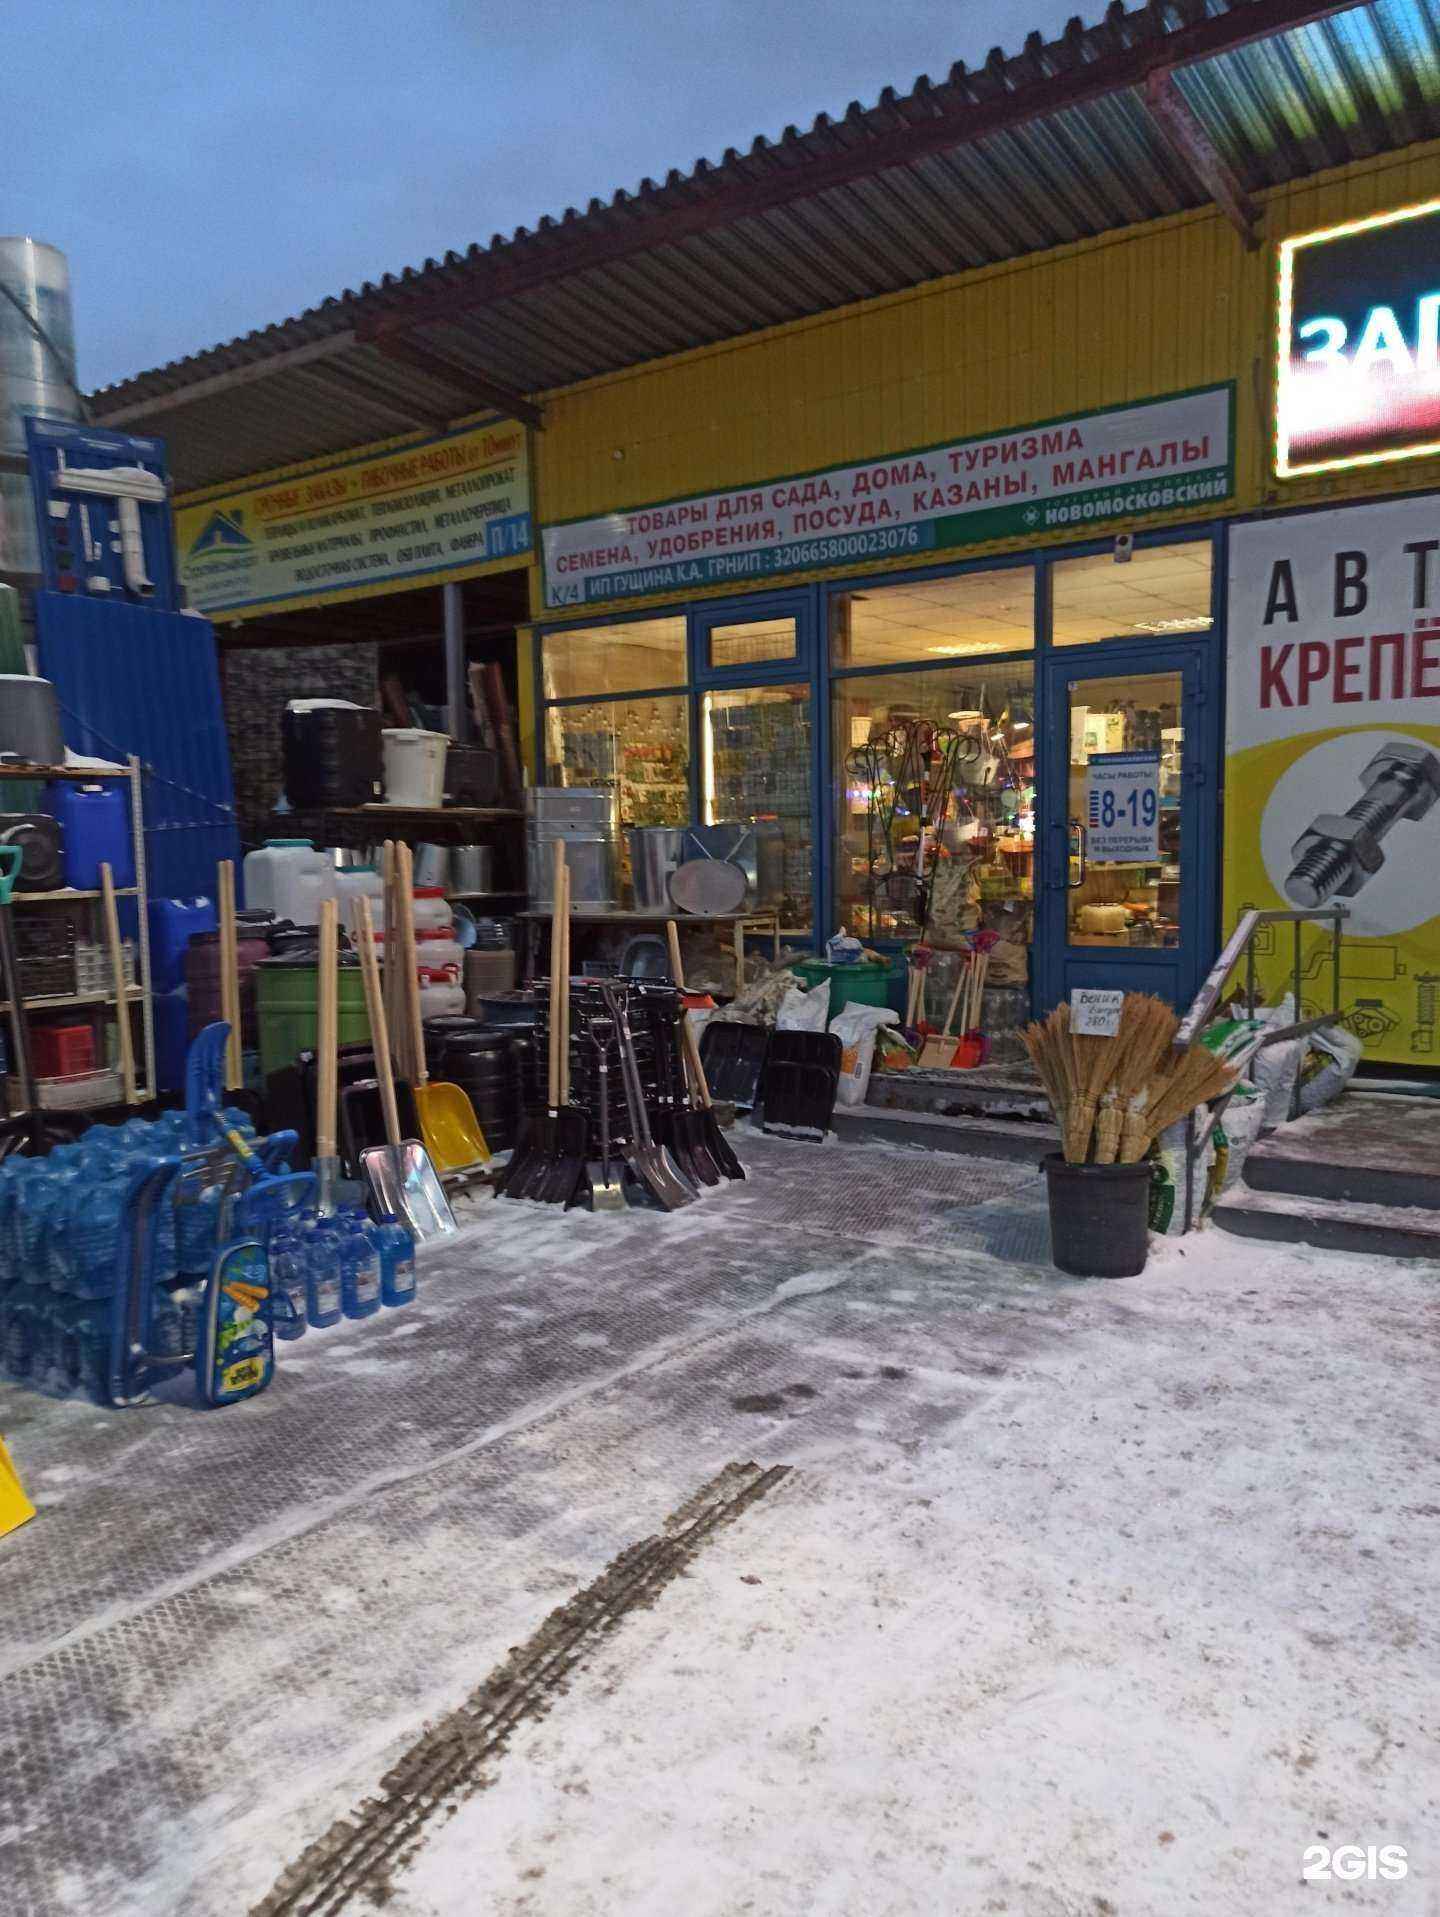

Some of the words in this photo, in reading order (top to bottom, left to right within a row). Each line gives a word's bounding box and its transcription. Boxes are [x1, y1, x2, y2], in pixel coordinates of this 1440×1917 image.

[556, 545, 639, 574] СЕМЕНА,
[646, 519, 784, 560] УДОБРЕНИЯ,
[793, 497, 901, 534] ПОСУДА,
[912, 471, 1038, 514] КАЗАНЫ,
[1052, 435, 1210, 487] МАНГАЛЫ
[626, 501, 708, 536] ТОВАРЫ
[715, 492, 763, 522] ДЛЯ
[772, 478, 841, 509] САДА,
[851, 461, 937, 497] ДОМА,
[948, 427, 1085, 475] ТУРИЗМА
[1045, 473, 1228, 525] НОВОМОСКОВСКИЙ
[491, 520, 529, 556] П/14
[590, 578, 611, 596] ИП
[612, 566, 674, 592] ГУЩИНА
[676, 563, 704, 583] К.А.
[773, 525, 919, 569] 320665800023076
[551, 583, 579, 605] К/4
[1093, 771, 1116, 780] ЧАСЫ
[1117, 770, 1153, 779] РАБОТЫ
[1101, 788, 1157, 828] 8-19
